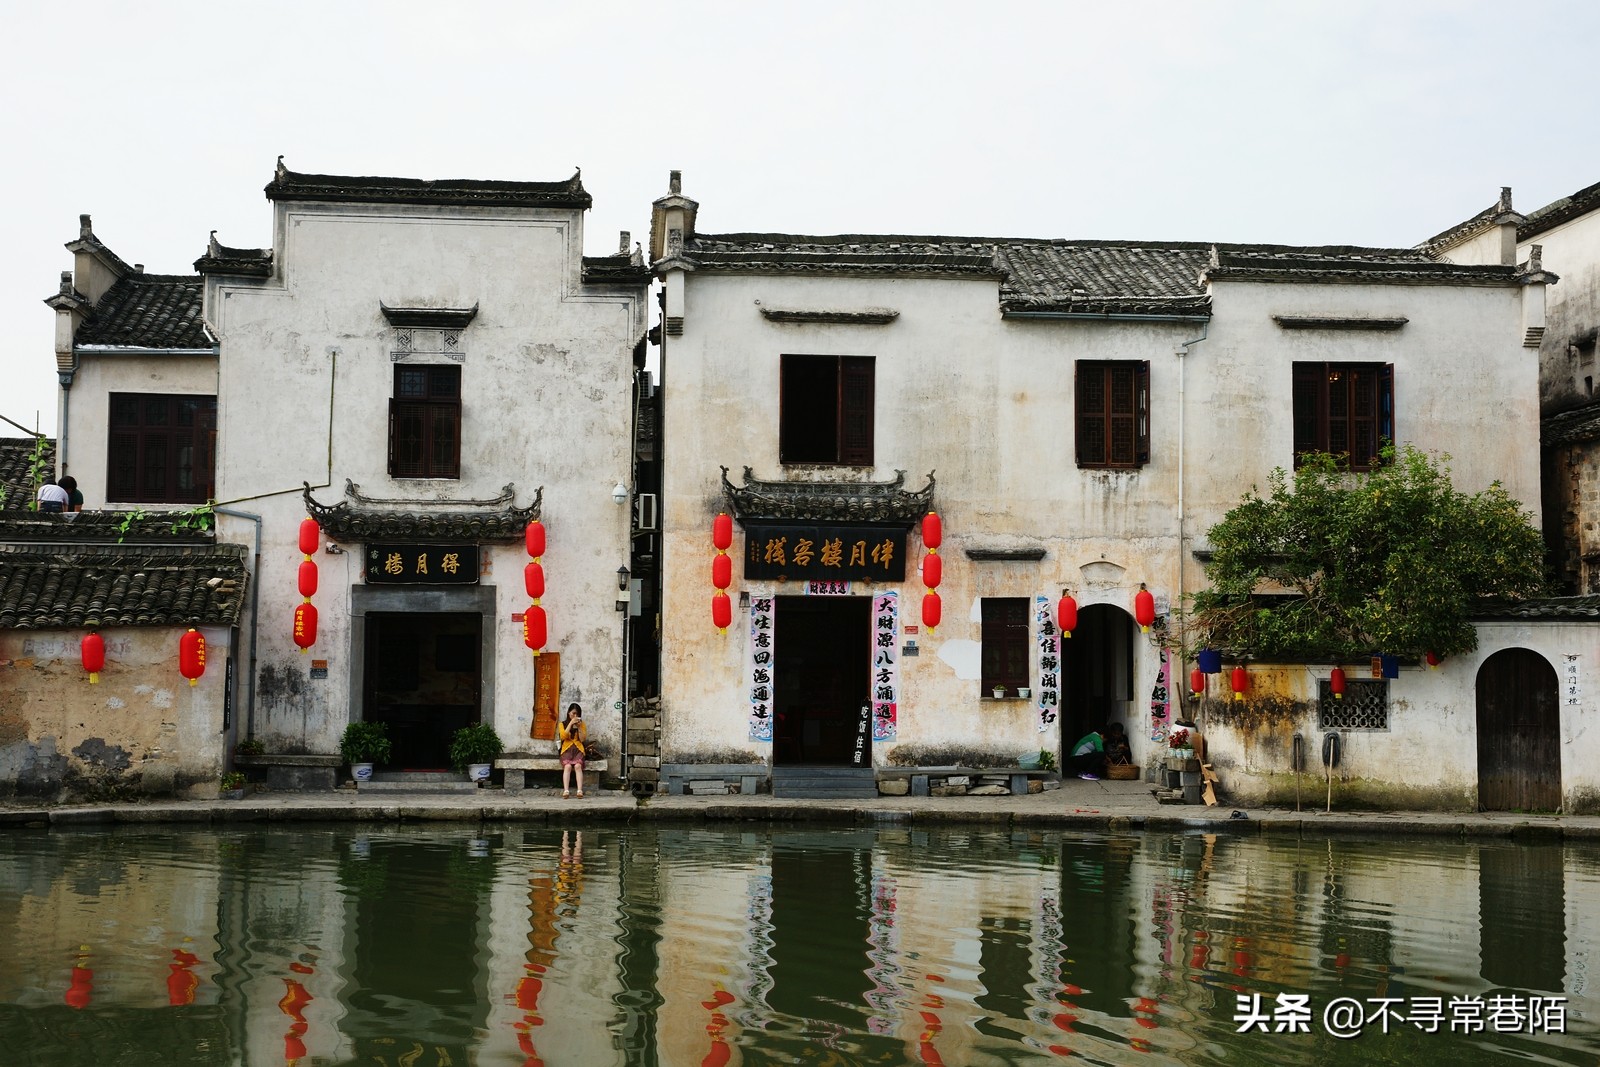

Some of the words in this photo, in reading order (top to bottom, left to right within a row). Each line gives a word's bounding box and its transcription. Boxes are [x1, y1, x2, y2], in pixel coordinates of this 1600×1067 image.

[384, 552, 461, 575] 得月楼
[854, 705, 869, 764] 吃饭住宿
